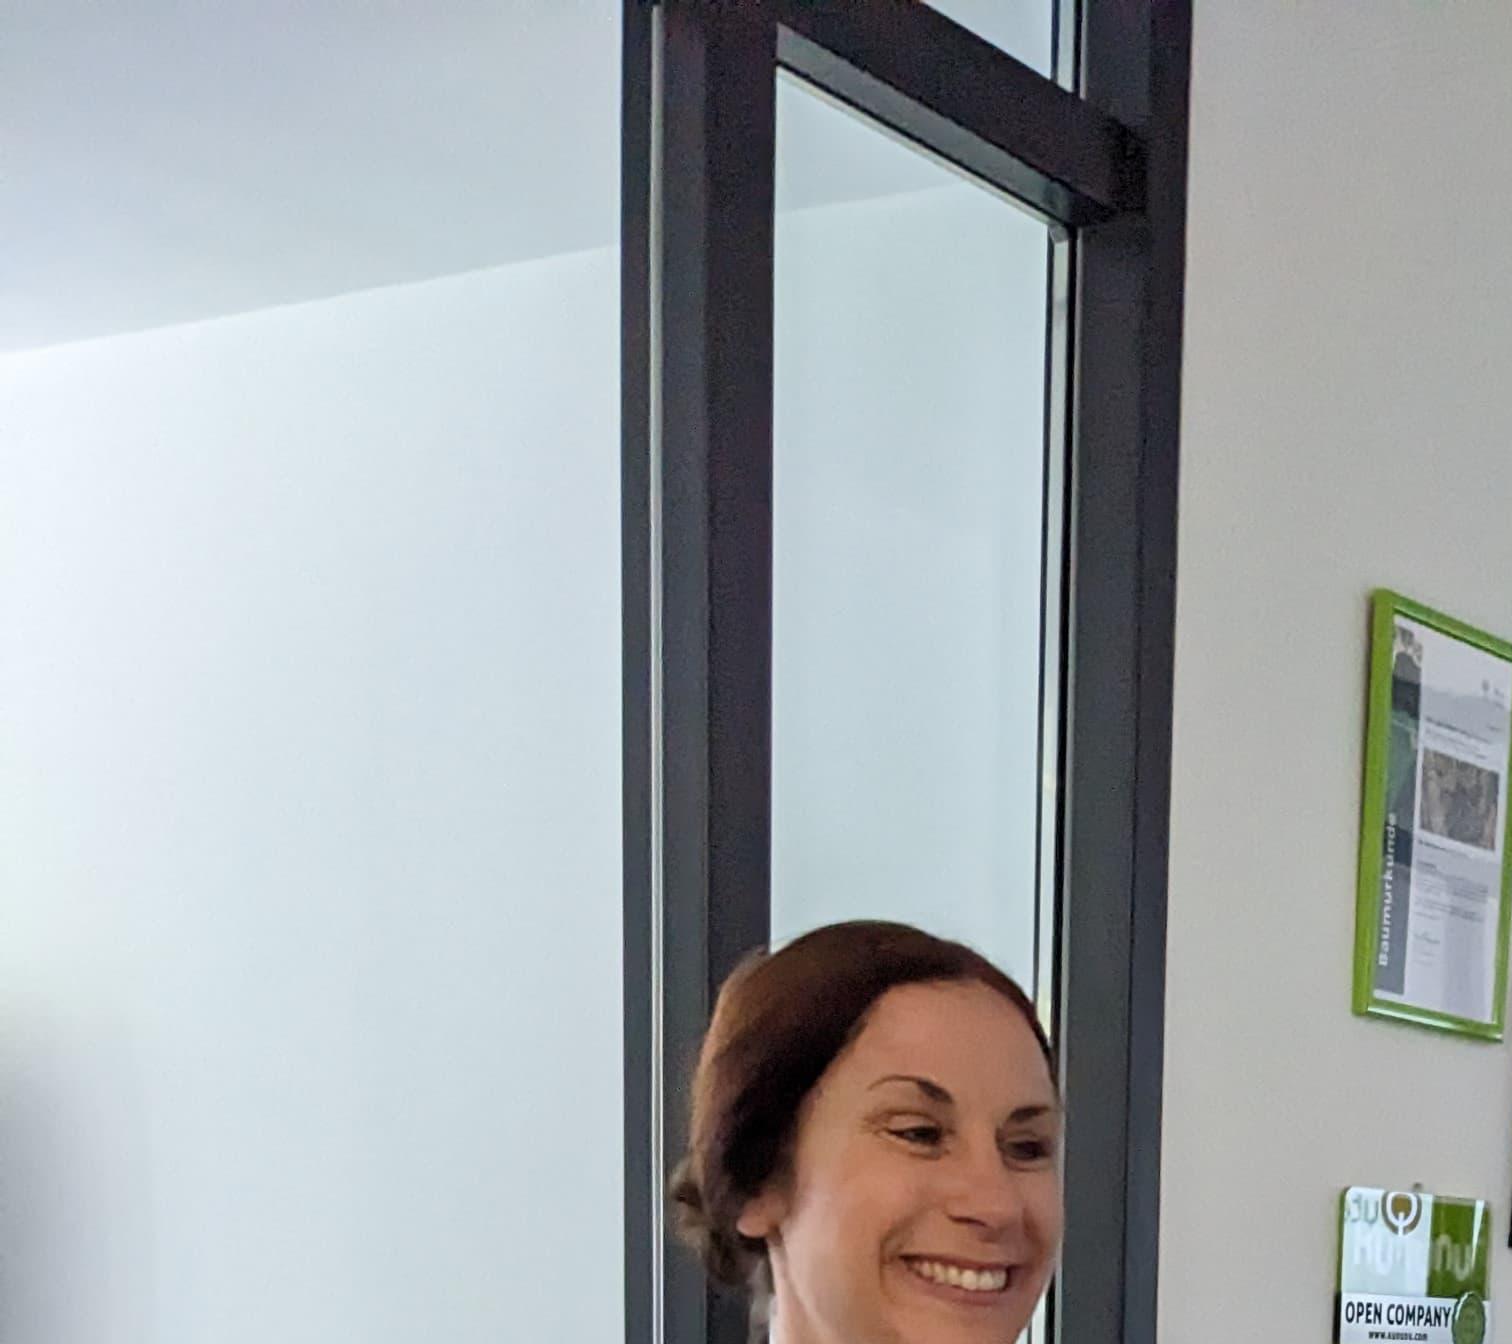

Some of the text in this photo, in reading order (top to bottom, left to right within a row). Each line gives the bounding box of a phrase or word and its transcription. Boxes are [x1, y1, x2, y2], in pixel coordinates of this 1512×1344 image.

[1377, 812, 1397, 967] Baumurkunde
[1345, 1301, 1382, 1325] OPEN
[1387, 1304, 1452, 1328] COMPANY
